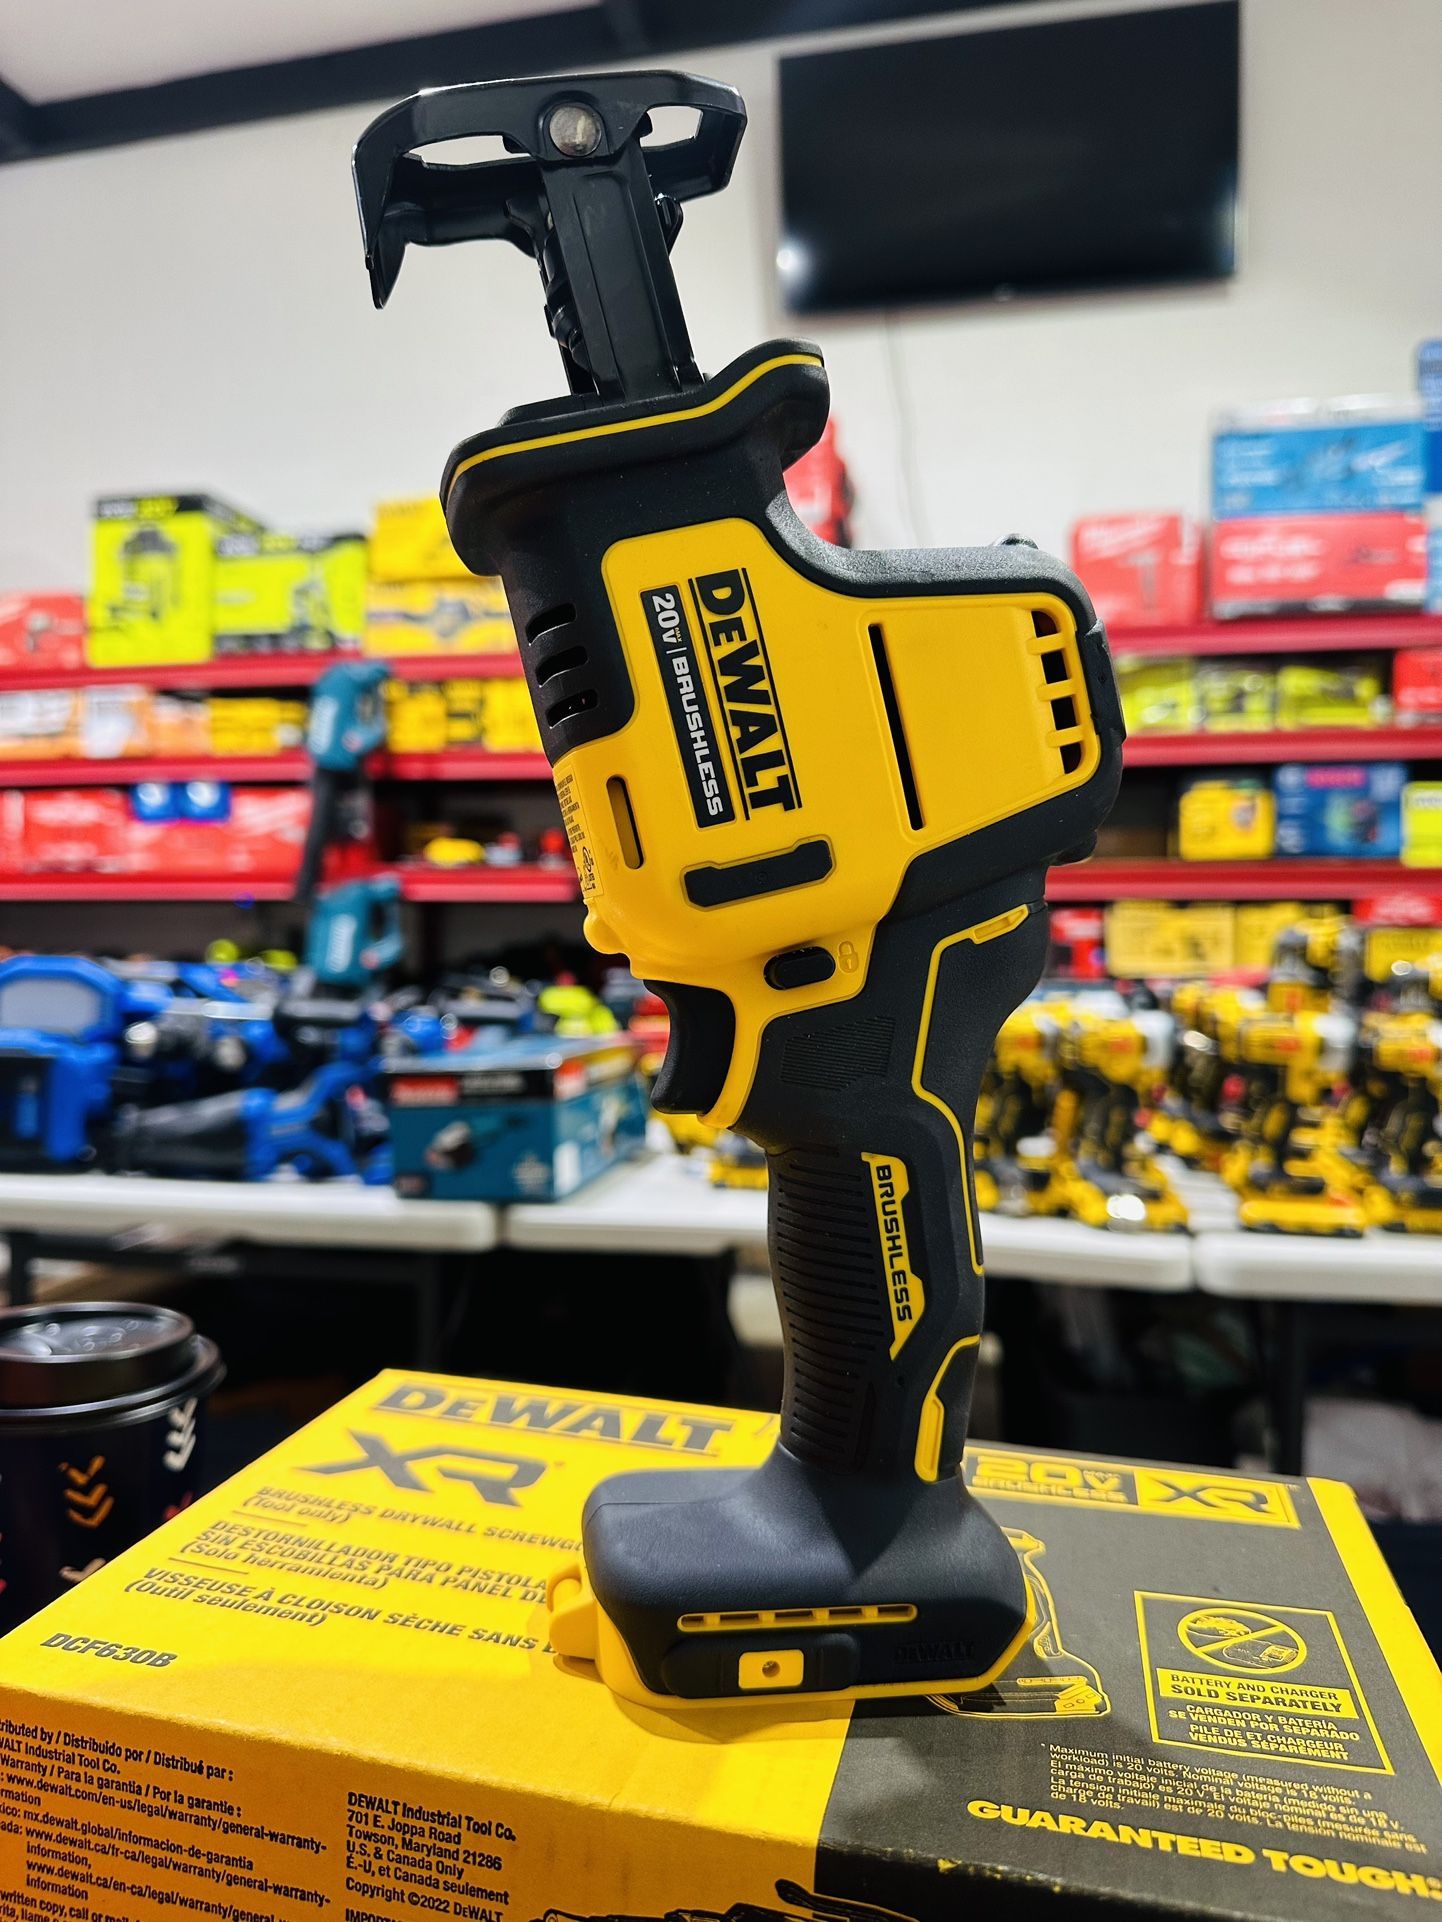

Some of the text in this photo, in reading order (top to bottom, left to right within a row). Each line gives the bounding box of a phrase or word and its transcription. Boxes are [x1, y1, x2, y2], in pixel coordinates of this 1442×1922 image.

[695, 569, 796, 812] DEWALT
[672, 655, 723, 816] BRUSHLESS
[876, 1165, 912, 1322] BRUSHLESS
[378, 1384, 734, 1452] DEWALT
[297, 1430, 548, 1507] XR
[243, 1496, 351, 1524] (Tool only)
[256, 1486, 373, 1516] BRUSHLESS
[379, 1508, 477, 1533] DRYWALL
[1150, 1478, 1278, 1515] XR
[180, 1541, 389, 1591] (Solo herramienta)
[196, 1531, 513, 1598] SIN ESCOBILLAS PARA PANEL
[210, 1520, 547, 1591] DESTORNILLADOR TIPO PISTOLA
[124, 1579, 329, 1627] (Outil seulement)
[143, 1567, 258, 1596] VISSEUSE
[260, 1587, 277, 1601] À
[278, 1593, 382, 1621] CLOISON
[468, 1628, 539, 1651] SANS
[40, 1633, 177, 1667] DCF630B
[1171, 1674, 1339, 1701] BATTERY AND CHARGER
[1171, 1684, 1343, 1714] SOLD SEPARATELY
[1168, 1710, 1361, 1742] SE VENDEN POR SEPARADO
[1186, 1704, 1262, 1722] CARGADOR
[1265, 1714, 1276, 1723] Y
[25, 1742, 121, 1775] Industrial Tool Co.
[40, 1727, 54, 1744] by
[63, 1732, 122, 1757] Distribuido
[125, 1748, 144, 1762] por
[153, 1751, 204, 1775] Distribué
[1189, 1724, 1345, 1752] PILE DE ET CHARGEUR
[1189, 1732, 1248, 1748] VENDUS
[57, 1766, 82, 1783] Para
[84, 1771, 94, 1785] la
[153, 1786, 172, 1802] Por
[174, 1790, 185, 1804] la
[1049, 1744, 1373, 1800] Maximum initial battery voltage (measured without a
[1050, 1752, 1109, 1767] workload)
[1113, 1760, 1123, 1769] is
[1126, 1762, 1143, 1772] 20
[1146, 1765, 1179, 1778] volts.
[1182, 1770, 1234, 1786] Nominal
[1237, 1781, 1282, 1795] voltage
[1287, 1787, 1299, 1796] is
[1320, 1792, 1355, 1805] volts.
[1050, 1760, 1388, 1820] El máximo voltaje inicial de la (medido sin una
[347, 1792, 516, 1841] DEWALT Industrial Tool Co.
[1050, 1768, 1366, 1825] carga de trabajo) es 20 voltaje nominal de
[1050, 1784, 1094, 1798] charge
[1097, 1791, 1113, 1800] de
[1117, 1794, 1161, 1809] travail)
[1163, 1802, 1183, 1813] est
[1186, 1805, 1203, 1815] de
[1207, 1808, 1224, 1818] 20
[1227, 1812, 1263, 1826] volts.
[1266, 1818, 1283, 1830] La
[1287, 1821, 1335, 1838] tension
[1051, 1776, 1066, 1785] La
[1069, 1778, 1115, 1793] tension
[1118, 1786, 1160, 1801] initiale
[1163, 1795, 1225, 1811] maximale
[1229, 1803, 1246, 1814] du
[1249, 1807, 1315, 1826] bloc-piles
[1051, 1792, 1125, 1810] de 18 volts.
[347, 1809, 461, 1845] 701 E. Joppa Road
[347, 1824, 503, 1871] Towson, Maryland 21286
[967, 1799, 1256, 1865] GUARANTEED
[26, 1841, 92, 1869] information,
[346, 1840, 464, 1880] U.S. & Canada Only
[26, 1874, 89, 1900] information
[346, 1876, 406, 1904] Copyright
[378, 1864, 391, 1878] et
[394, 1867, 440, 1889] Canada
[443, 1882, 509, 1905] seulement
[39, 1899, 67, 1918] copy,
[69, 1907, 88, 1921] call
